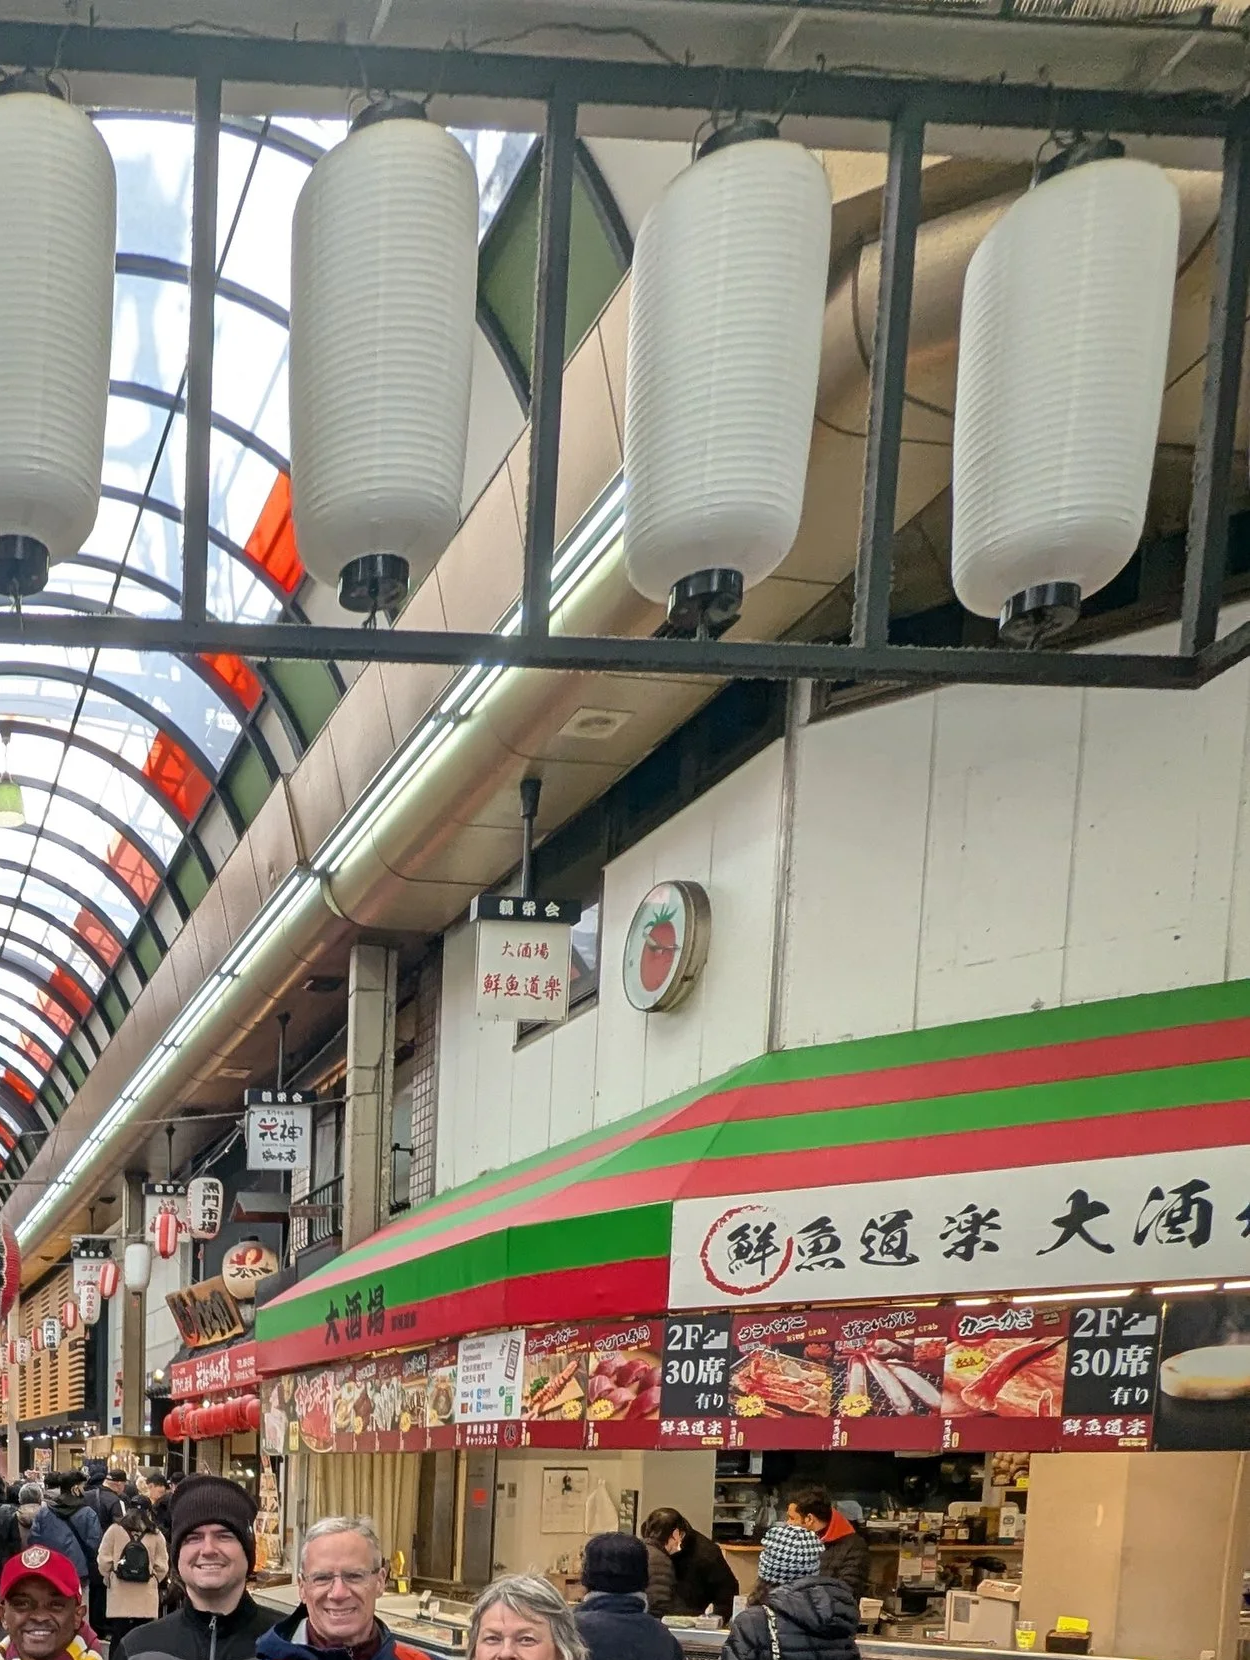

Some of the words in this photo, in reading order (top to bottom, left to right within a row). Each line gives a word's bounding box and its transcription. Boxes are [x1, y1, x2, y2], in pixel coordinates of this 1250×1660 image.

[501, 941, 550, 960] 大酒場
[483, 973, 561, 1000] 鮮魚道楽
[200, 1182, 220, 1233] 黒門市場
[726, 1204, 1002, 1275] 鮮魚道楽
[1036, 1178, 1250, 1256] 大酒
[325, 1284, 385, 1345] 大酒場
[841, 1310, 918, 1337] ずわいがに
[1073, 1307, 1124, 1338] 2F
[667, 1323, 703, 1351] 2F
[665, 1357, 727, 1385] 30席
[1070, 1345, 1152, 1377] 30席
[695, 1392, 724, 1410] 有り
[1110, 1386, 1149, 1406] 有り
[660, 1420, 723, 1436] 鮮魚道楽
[1063, 1419, 1146, 1437] 鮮魚道楽
